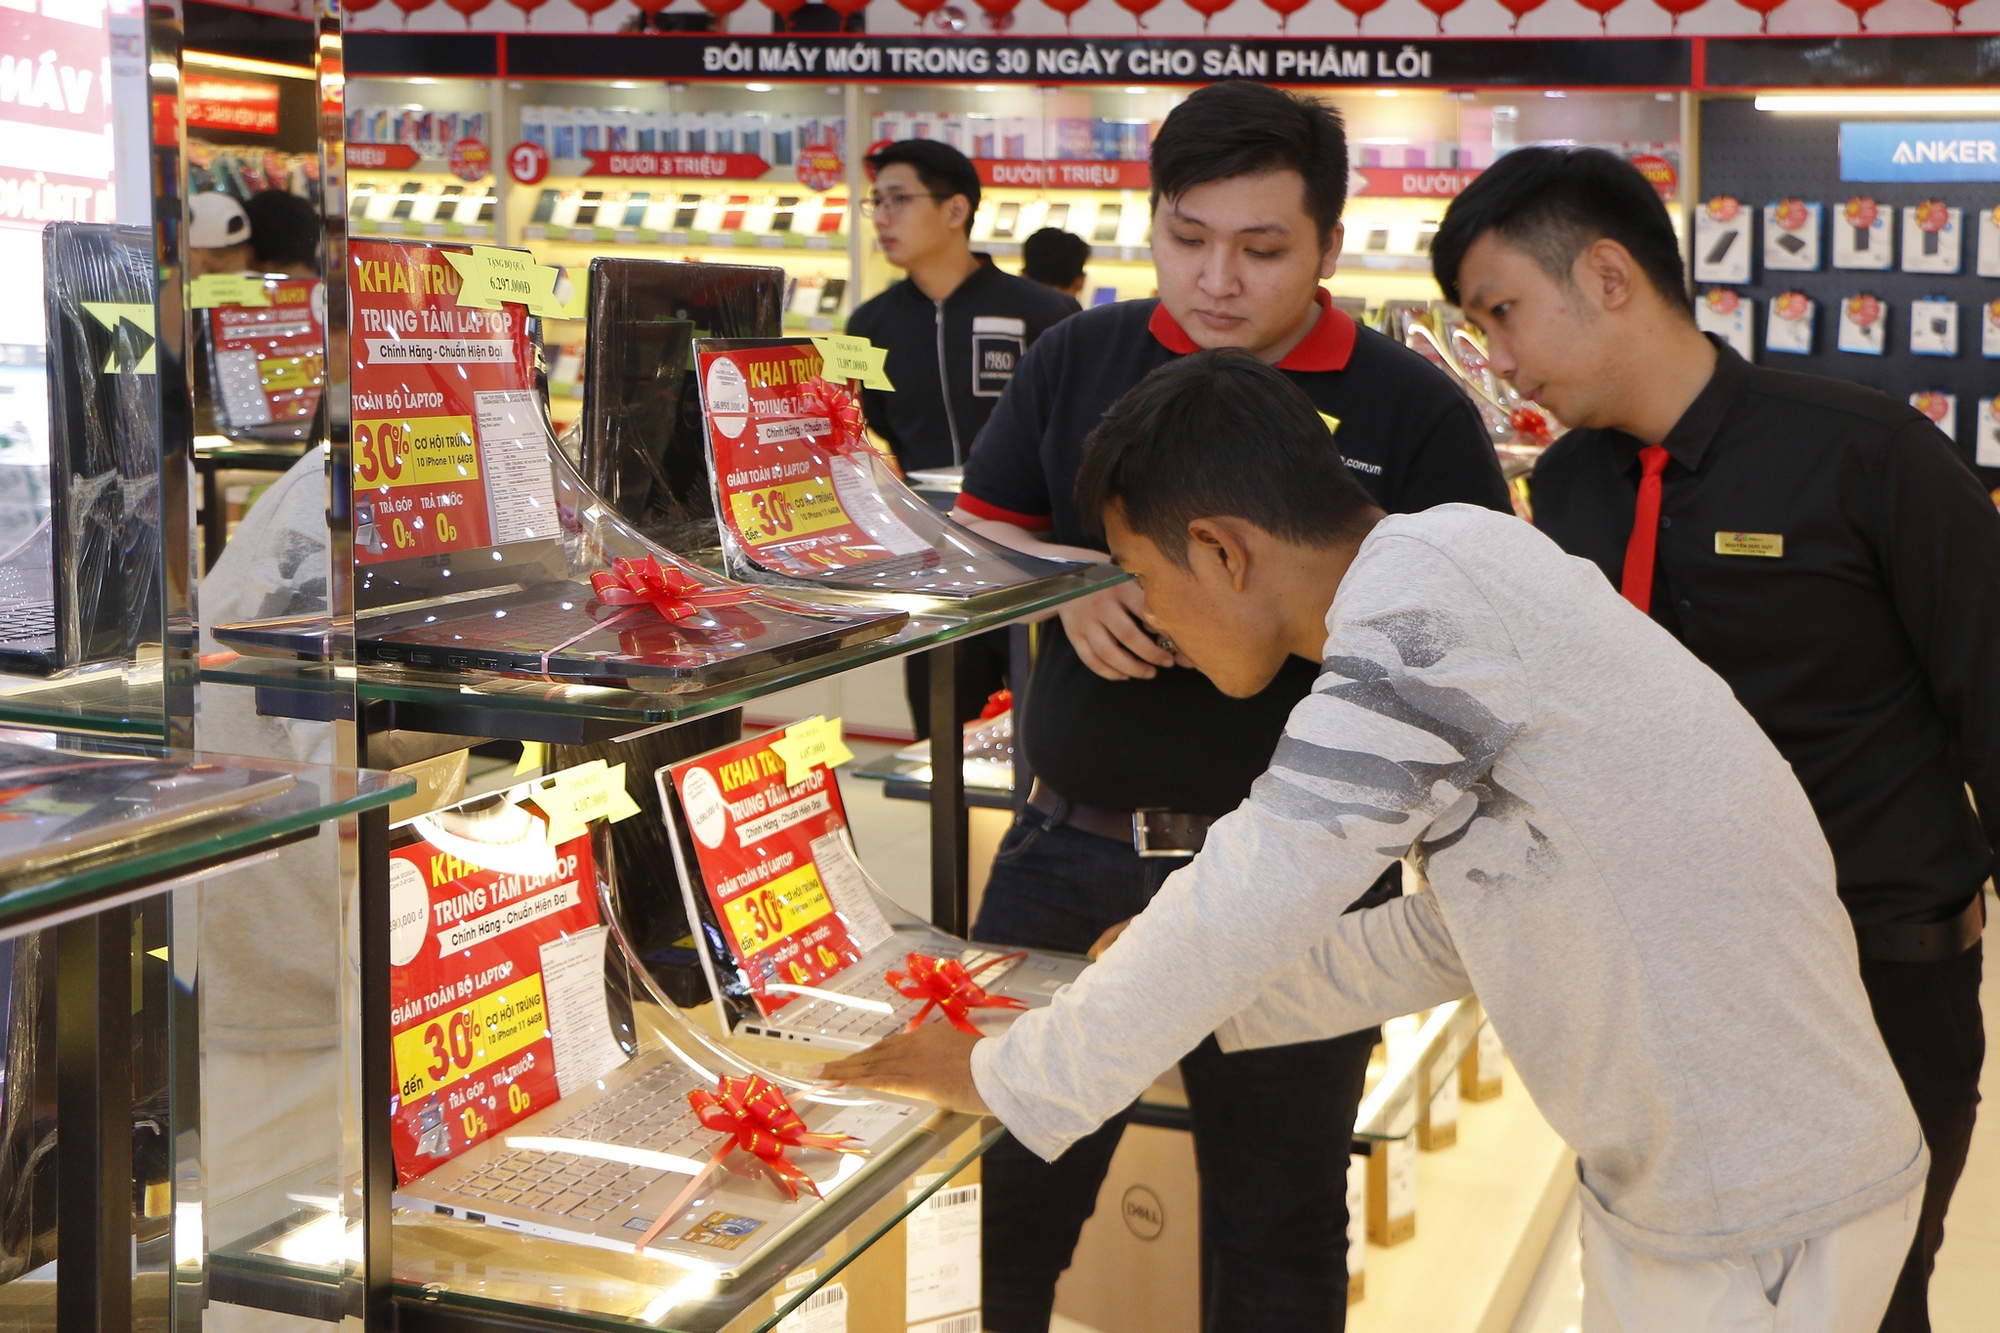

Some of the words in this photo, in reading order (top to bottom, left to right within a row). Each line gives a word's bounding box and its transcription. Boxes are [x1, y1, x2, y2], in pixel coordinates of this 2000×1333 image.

[758, 41, 821, 73] MÁY
[825, 41, 882, 73] MỚI
[887, 47, 989, 74] TRONG
[996, 47, 1030, 74] 30
[1036, 43, 1123, 75] NGÀY
[1127, 48, 1197, 76] CHO
[346, 147, 386, 168] RIỆU
[611, 152, 659, 175] DƯỚI
[660, 155, 673, 175] 3
[674, 156, 727, 179] TRIỆU
[1891, 140, 1999, 165] ANKER
[992, 162, 1045, 184] DƯỚI
[1046, 165, 1057, 183] 1
[1060, 164, 1120, 187] TRIỆU
[357, 260, 415, 294] KHAI
[490, 276, 531, 294] 6.297.000Đ
[360, 309, 418, 333] TRUNG
[421, 305, 454, 333] TÂM
[457, 311, 513, 335] LAPTOP
[379, 344, 407, 358] Chính
[438, 341, 466, 358] Chuẩn
[467, 345, 486, 361] Hiện
[488, 346, 503, 361] Đại
[984, 350, 1016, 371] 1980
[749, 359, 788, 389] KHAI
[352, 390, 384, 411] TOÀN
[386, 389, 401, 414] BỘ
[404, 392, 444, 409] LAPTOP
[753, 397, 790, 414] TRUNG
[355, 422, 410, 483] 30%
[414, 435, 428, 450] CƠ
[430, 434, 445, 452] HỘI
[446, 433, 473, 448] TRÚNG
[416, 457, 425, 467] 10
[426, 456, 447, 466] iPhone
[448, 455, 455, 465] 11
[457, 454, 474, 464] 64GB
[726, 468, 748, 487] GIẢM
[749, 466, 770, 483] TOÀN
[784, 461, 810, 477] LAPTOP
[1340, 455, 1382, 475] .com.vn
[379, 496, 394, 514] TRẢ
[395, 496, 413, 513] GÓP
[420, 492, 435, 509] TRẢ
[800, 512, 808, 520] 10
[808, 510, 823, 518] iPhone
[392, 517, 416, 549] 0%
[719, 756, 760, 793] KHAI
[730, 793, 766, 823] TRUNG
[765, 781, 790, 809] TÂM
[789, 769, 825, 800] LAPTOP
[745, 823, 762, 839] Chính
[780, 807, 800, 824] Chuẩn
[430, 853, 485, 888] KHA
[716, 874, 738, 899] GIẢM
[737, 867, 759, 889] TOÀN
[757, 860, 770, 881] BỘ
[769, 850, 794, 875] LAPTOP
[433, 888, 486, 927] TRUNG
[488, 873, 522, 905] TÂM
[523, 855, 578, 893] LAOP
[417, 908, 424, 920] đ
[451, 927, 477, 946] Chính
[507, 902, 534, 925] Chuẩn
[534, 896, 552, 914] Hiện
[554, 890, 568, 908] Đại
[390, 995, 422, 1026] GIẢM
[423, 984, 455, 1011] TOÀN
[457, 974, 473, 998] BỘ
[475, 960, 514, 990] LAPTOP
[485, 1013, 499, 1028] CƠ
[500, 1005, 515, 1022] HỘI
[515, 993, 541, 1015] TRÚNG
[488, 1035, 497, 1045] 10
[497, 1025, 518, 1042] iPhone
[518, 1019, 526, 1031] 11
[526, 1012, 543, 1026] 64GB
[423, 1009, 481, 1082] 30%
[402, 1073, 424, 1097] đến
[449, 1087, 466, 1110] TRẢ
[466, 1081, 486, 1101] GÓP
[462, 1106, 488, 1139] 0%
[1127, 1202, 1159, 1225] DELL
